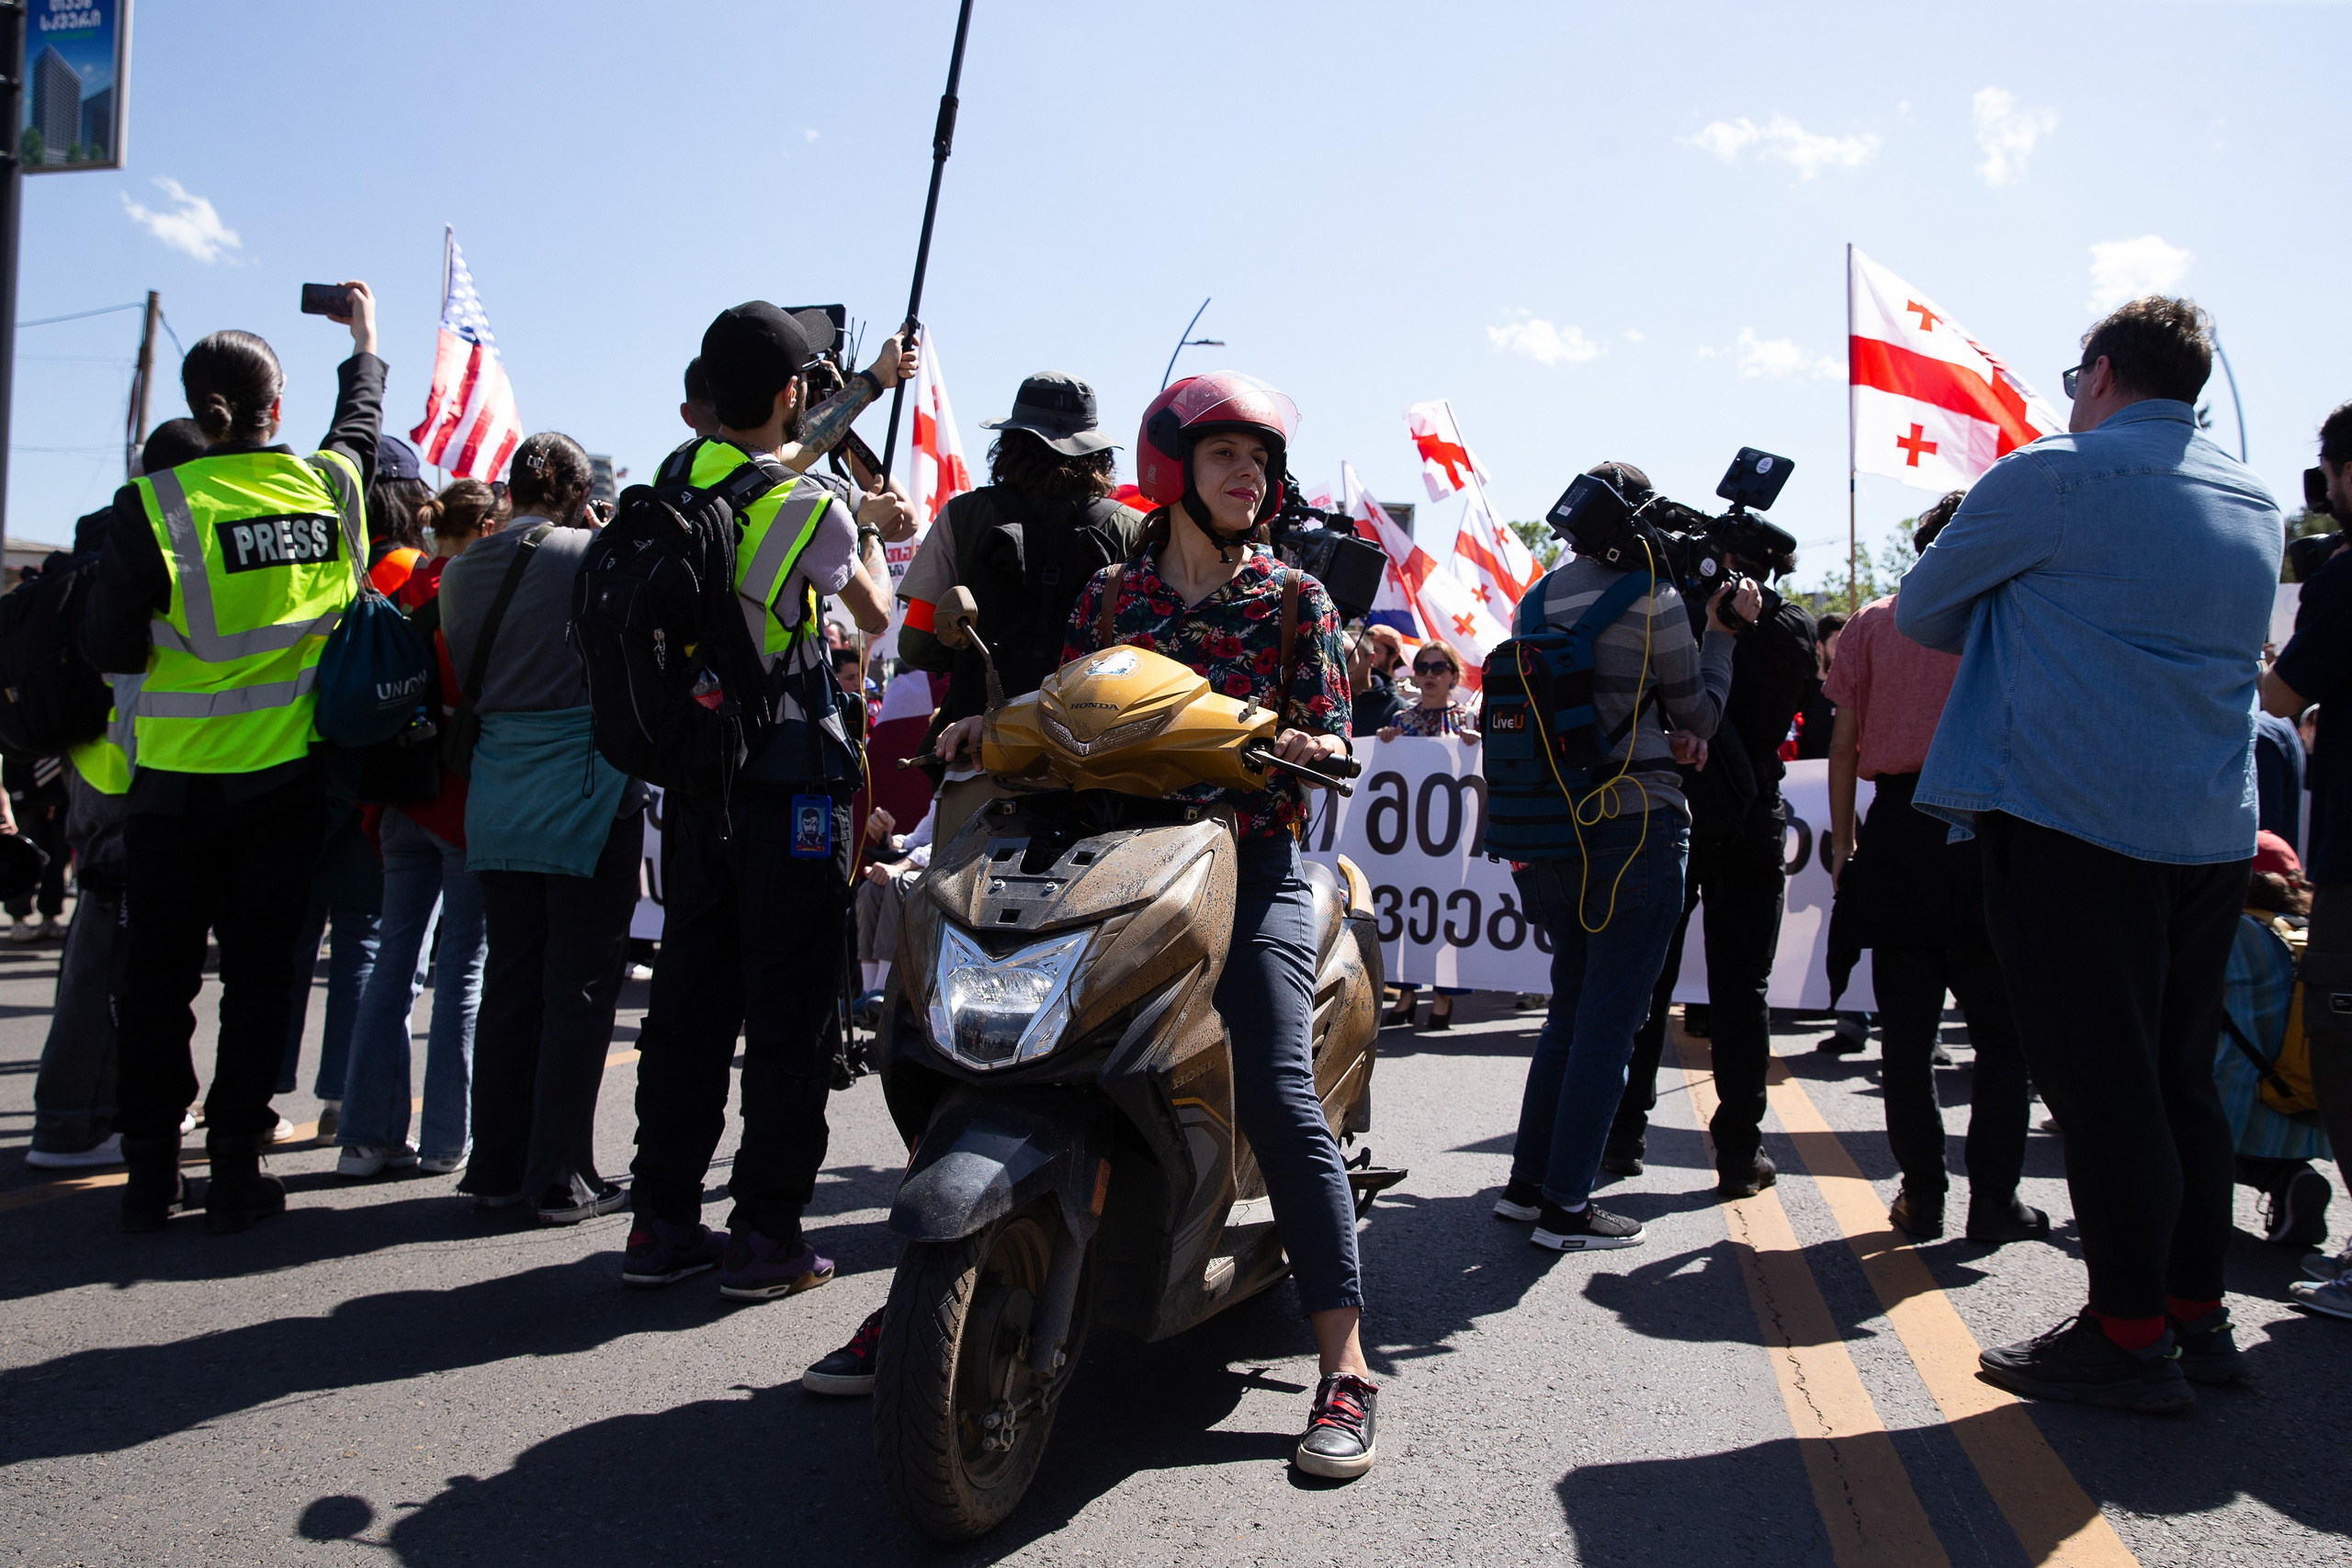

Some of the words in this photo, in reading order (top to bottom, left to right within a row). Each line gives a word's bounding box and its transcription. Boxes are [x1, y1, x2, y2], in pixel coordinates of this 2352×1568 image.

[848, 437, 868, 458] EOS
[232, 519, 329, 566] PRESS
[1069, 702, 1120, 711] HONDA
[1492, 711, 1524, 729] LiveU
